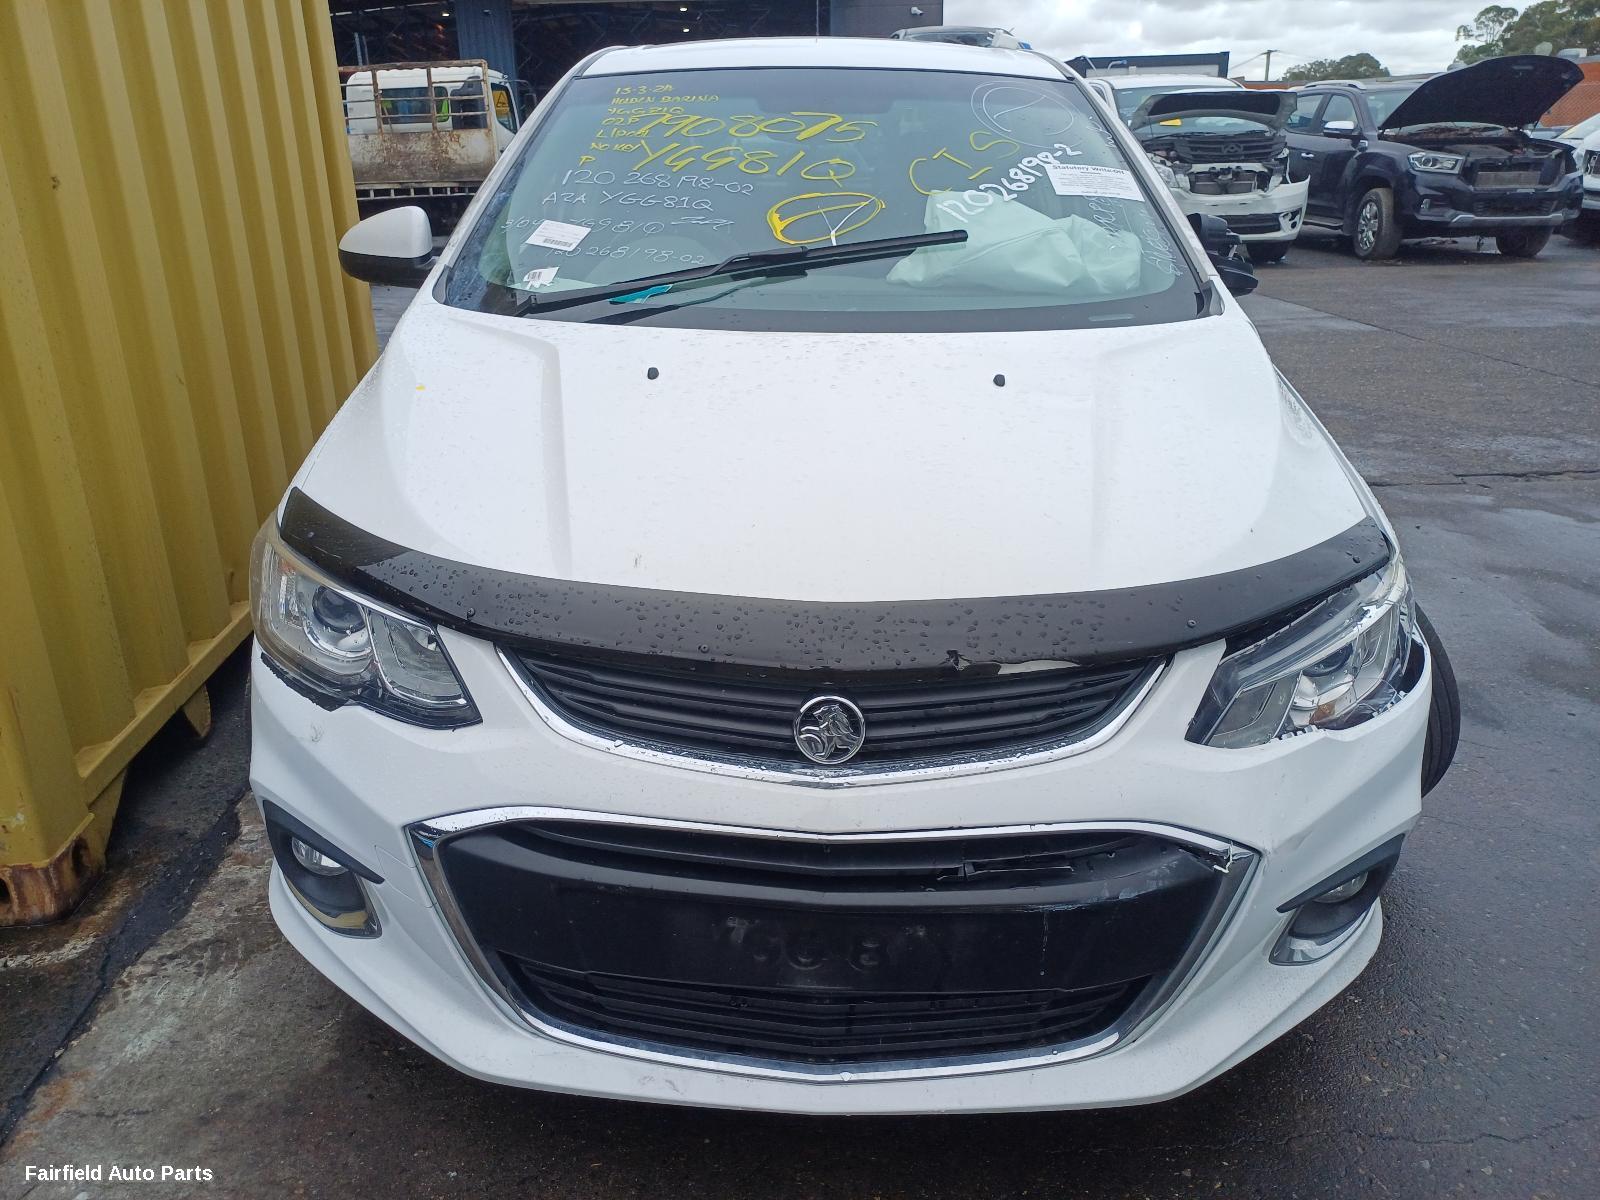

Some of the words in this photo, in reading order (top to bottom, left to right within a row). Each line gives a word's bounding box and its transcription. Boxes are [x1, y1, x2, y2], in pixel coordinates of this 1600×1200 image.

[632, 140, 856, 188] YGG81Q
[562, 169, 616, 185] 120
[599, 190, 714, 212] YGG81Q
